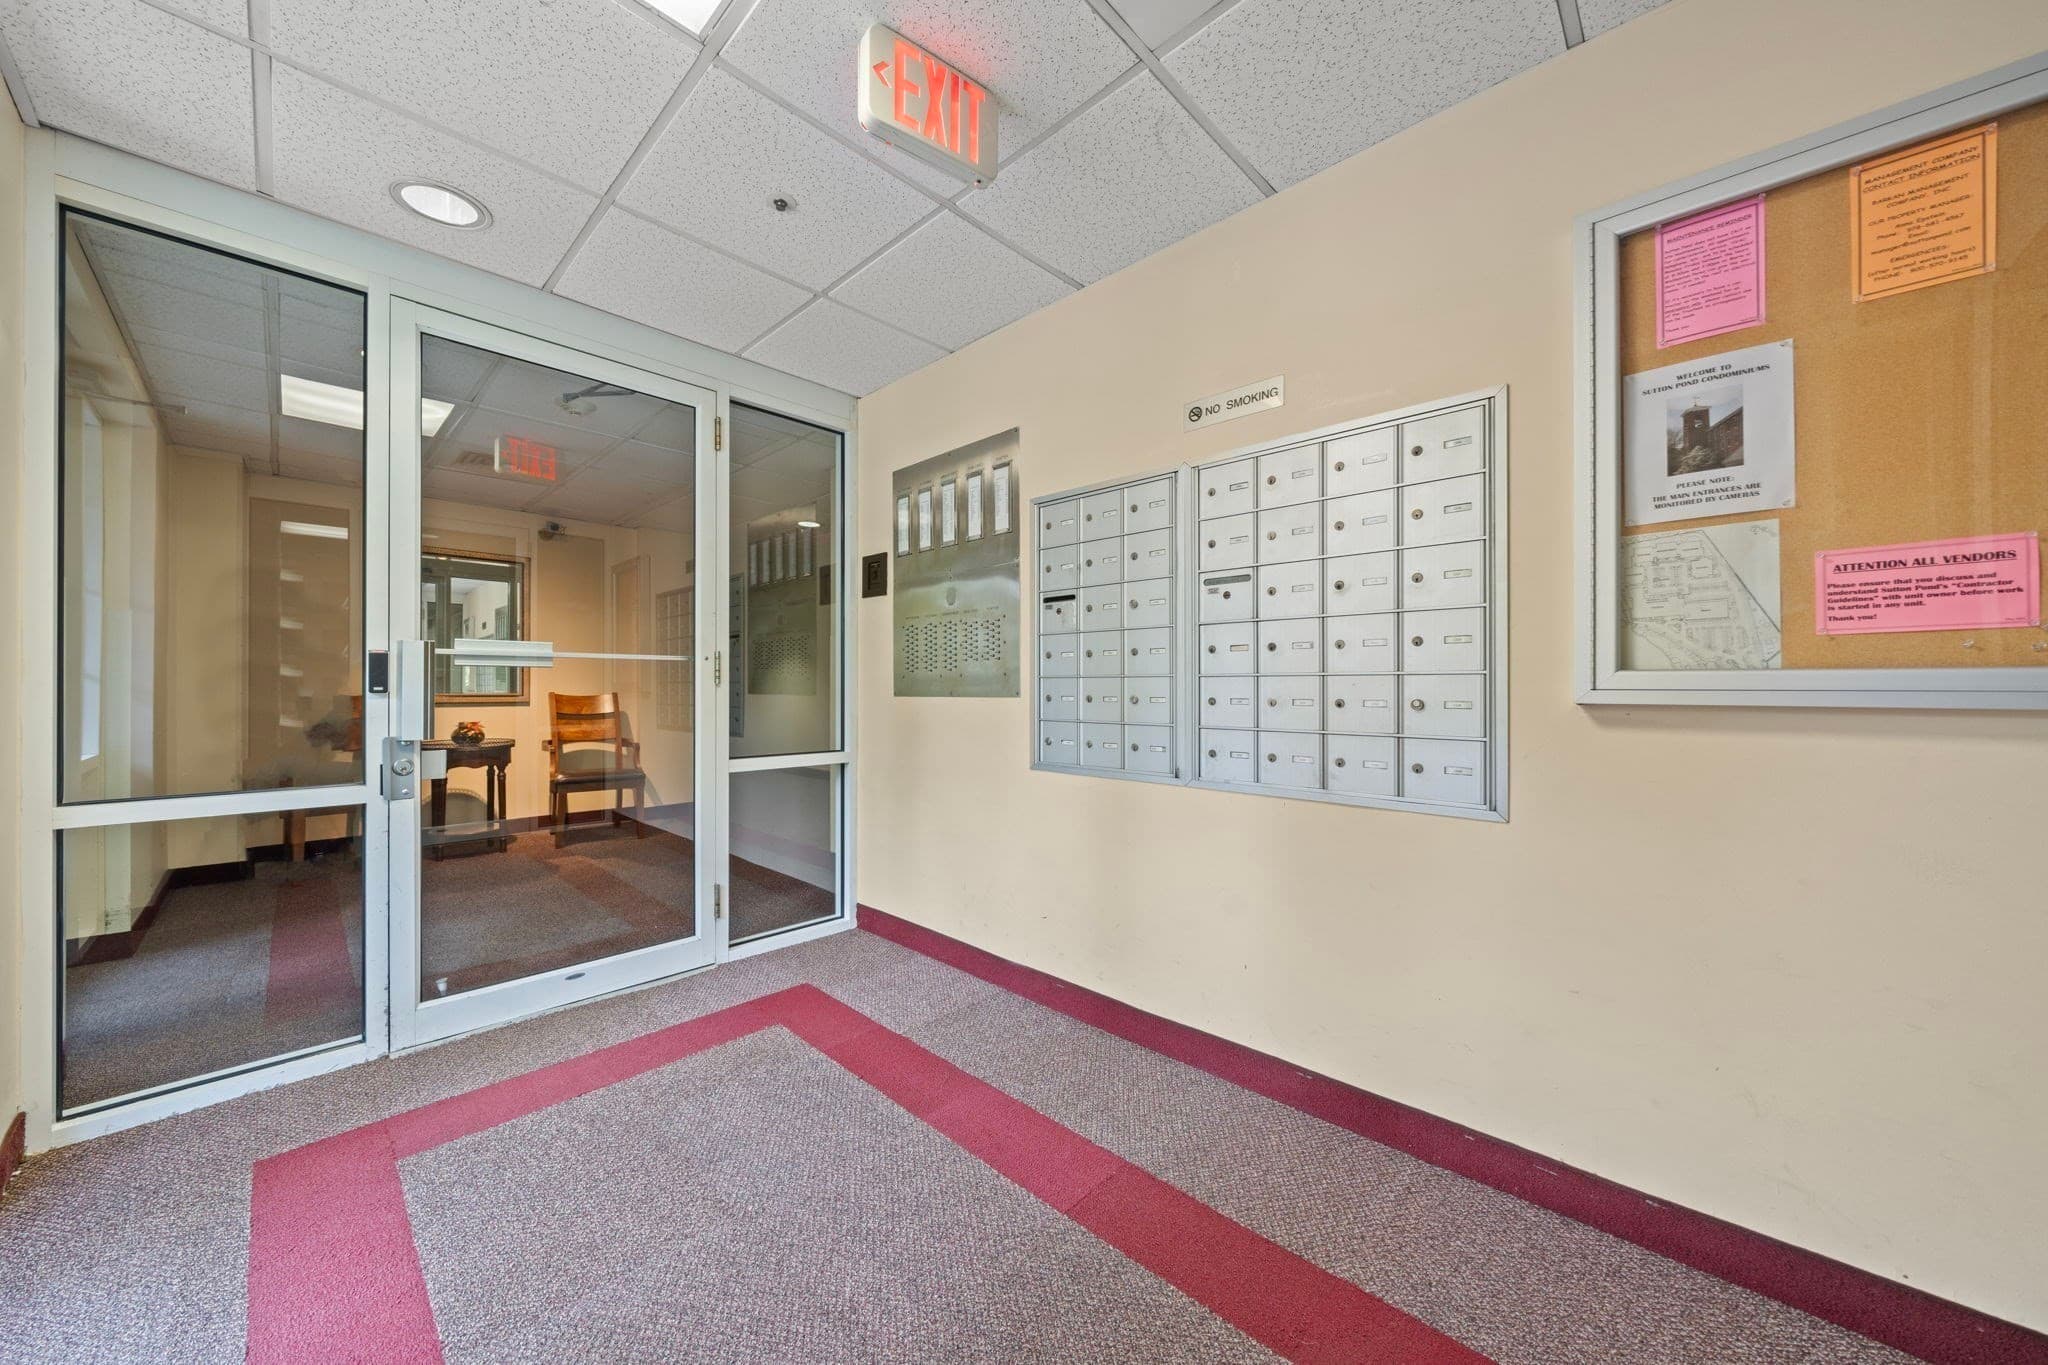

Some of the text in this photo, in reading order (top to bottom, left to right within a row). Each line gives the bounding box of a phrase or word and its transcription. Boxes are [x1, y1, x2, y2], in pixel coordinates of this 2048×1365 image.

[894, 39, 985, 165] EXIT
[1863, 153, 1981, 193] CONTACT INFORMATION
[1865, 146, 1978, 184] MANAGEMENT COMPANY
[1907, 173, 1970, 195] MANAGEMENT
[1642, 364, 1770, 396] SUTTON POND CONDOMINIUMS
[1676, 366, 1718, 381] WELCOME
[1205, 387, 1279, 416] NO SMOKING
[1652, 482, 1762, 503] THE MAIN ENTRANCES ARE
[1676, 475, 1735, 489] PLEASE NOTE:
[1654, 497, 1702, 510] MONITORED
[1719, 491, 1760, 501] CAMERAS
[1833, 550, 2016, 573] ATTENTION ALL VENDORS
[1827, 581, 1855, 589] Please
[1894, 577, 1912, 585] that
[1915, 576, 1933, 584] you
[1827, 580, 2014, 596] understand Sutton Pond's "Contractor
[1882, 593, 1902, 601] with
[1960, 588, 1994, 596] before
[1997, 586, 2024, 594] work
[1857, 614, 1877, 622] you!
